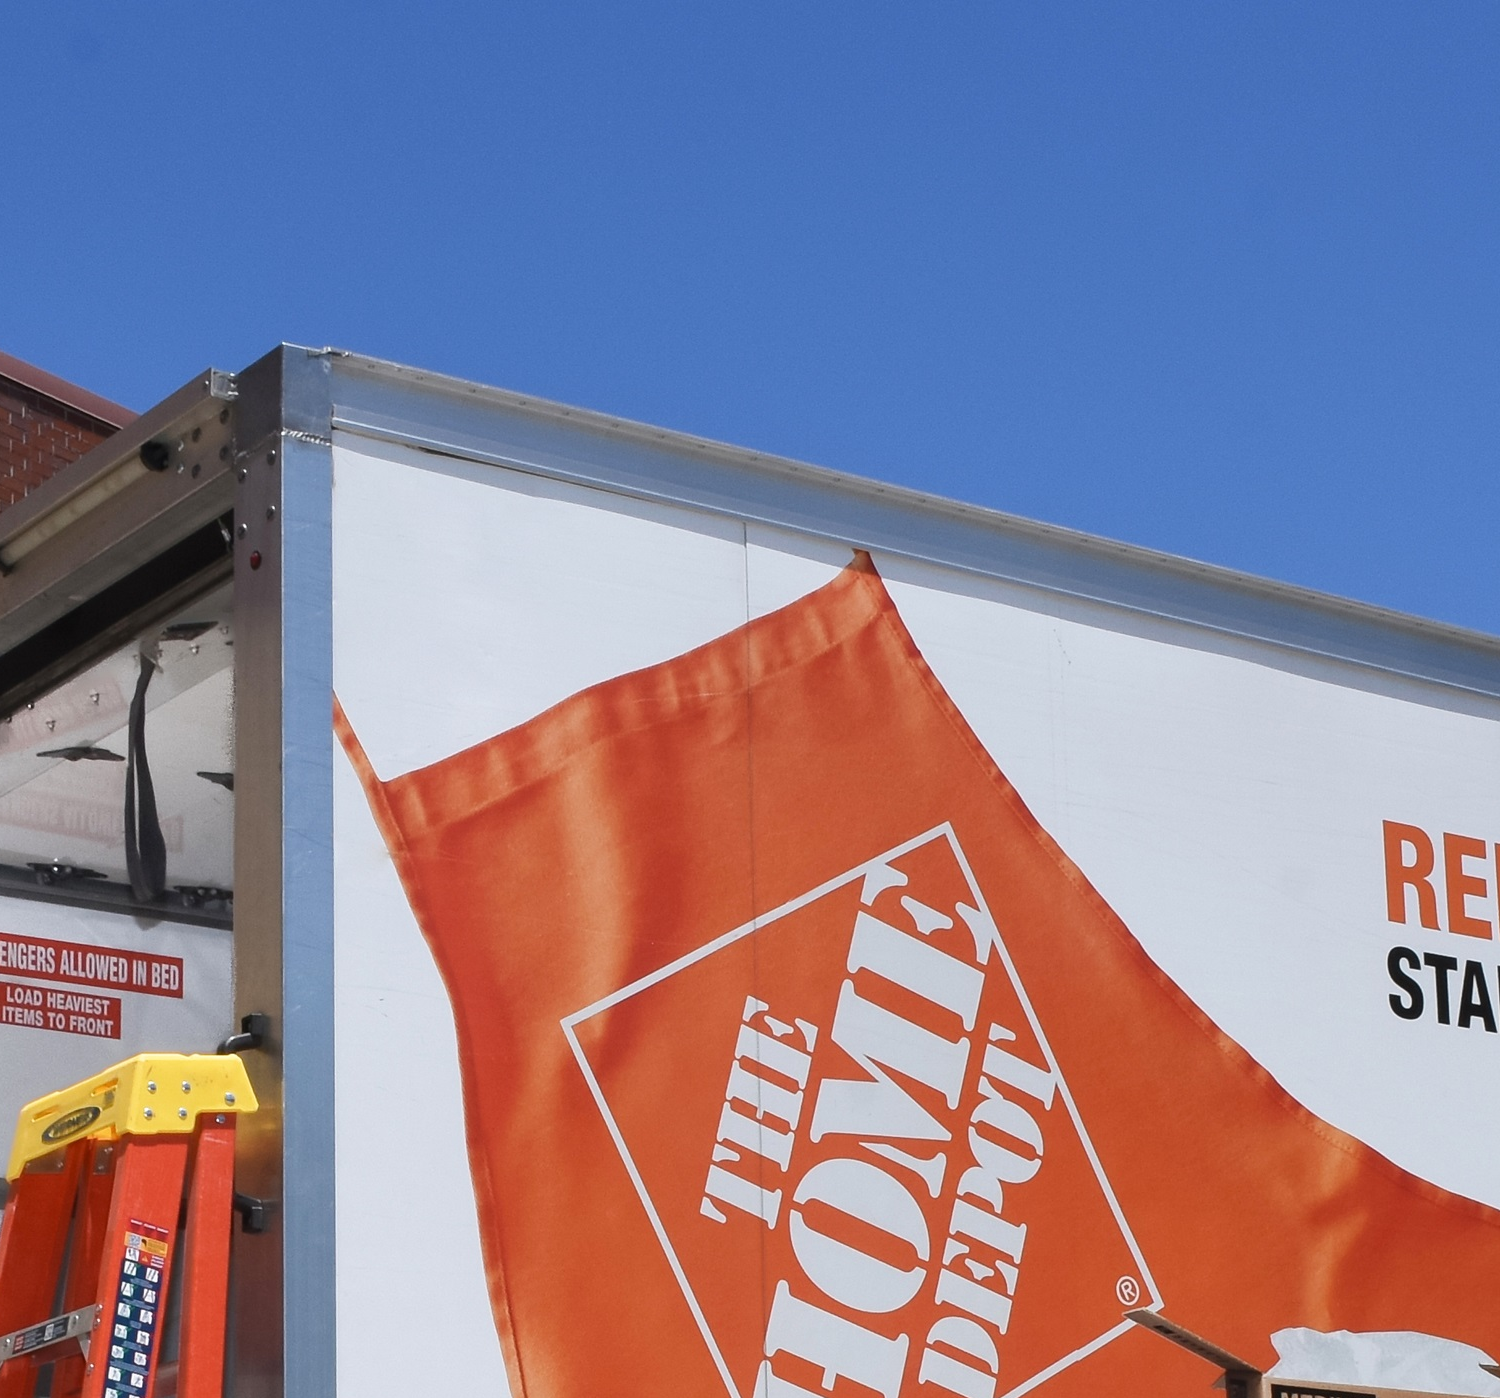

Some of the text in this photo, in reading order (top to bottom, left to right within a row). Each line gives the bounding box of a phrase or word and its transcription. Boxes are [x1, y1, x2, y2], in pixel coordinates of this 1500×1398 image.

[60, 950, 128, 984] ALLOWED
[133, 960, 147, 986] IN
[152, 962, 180, 990] BED
[6, 986, 110, 1016] LOAD HEAVIEST
[2, 1006, 114, 1036] ITEMS TO FRONT
[700, 995, 819, 1229] THE
